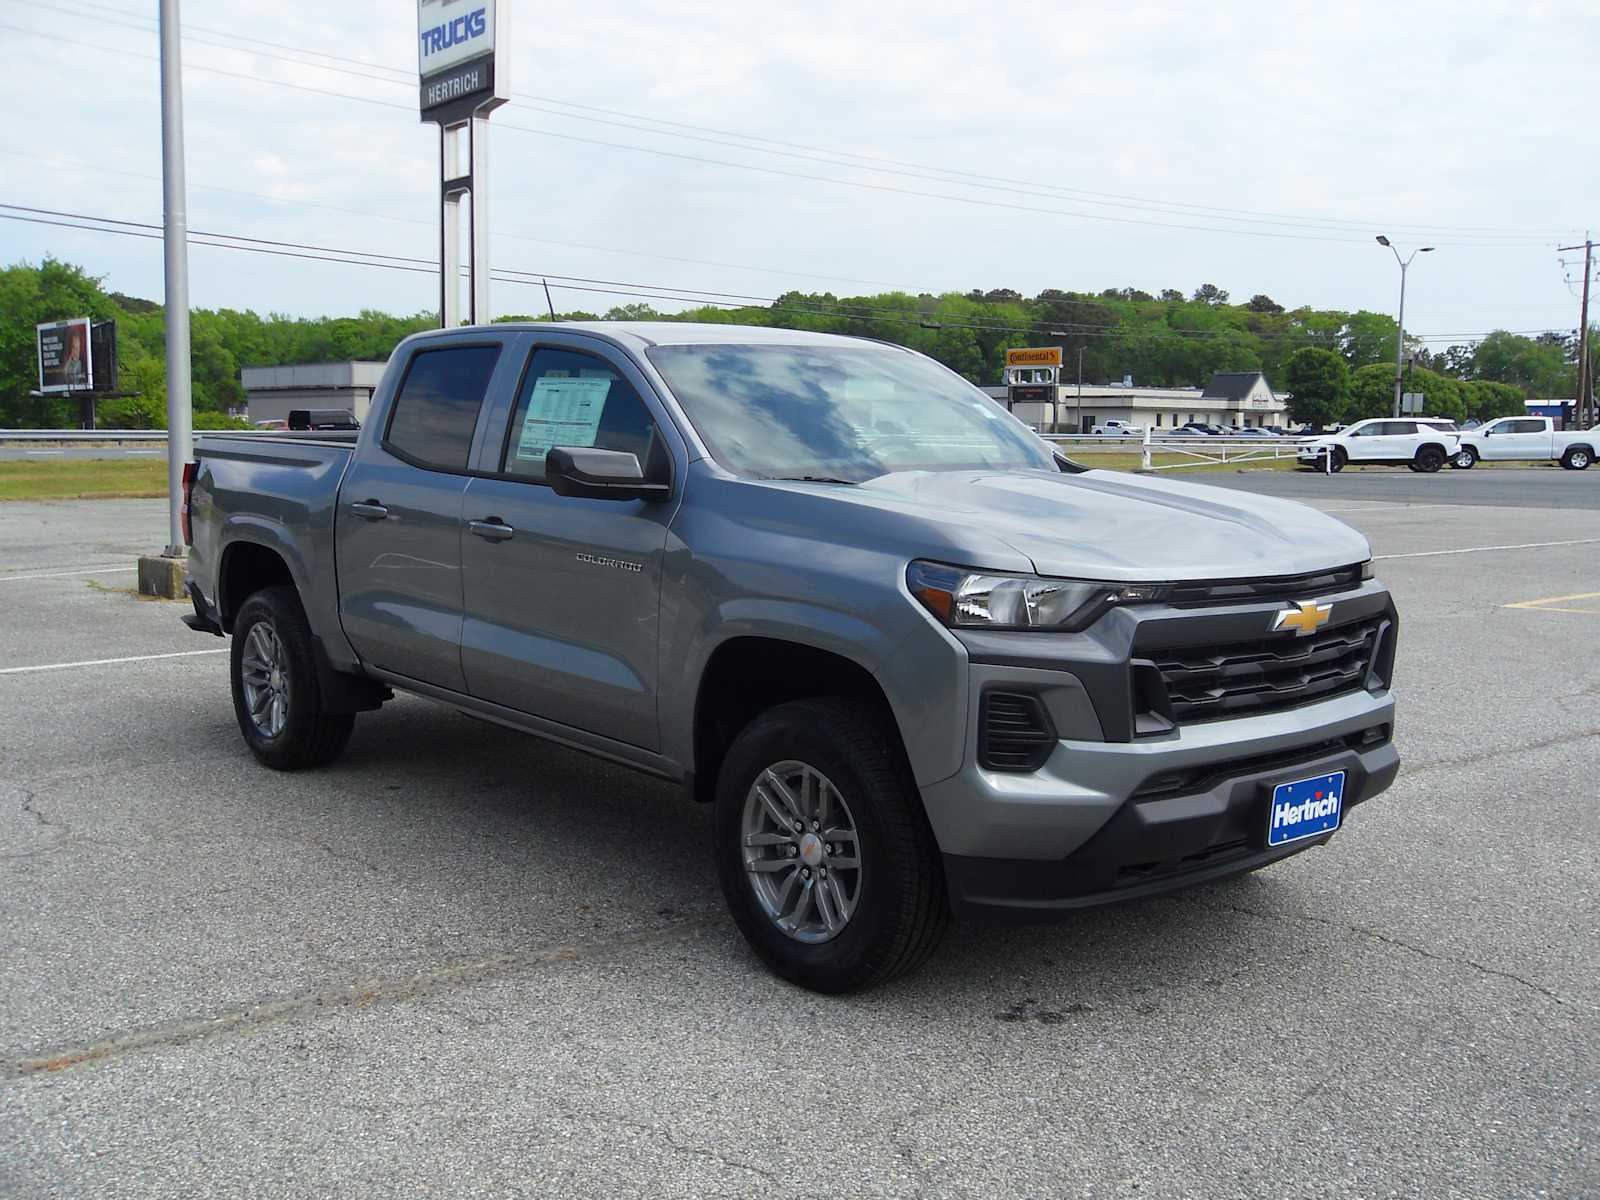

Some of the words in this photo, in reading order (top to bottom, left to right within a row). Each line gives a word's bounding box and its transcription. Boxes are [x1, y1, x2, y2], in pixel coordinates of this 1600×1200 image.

[421, 7, 486, 57] TRUCKS
[428, 71, 479, 105] HERTRICH
[1010, 351, 1049, 364] Continental
[576, 552, 642, 572] COLORADO
[1273, 791, 1338, 829] Hertrich
